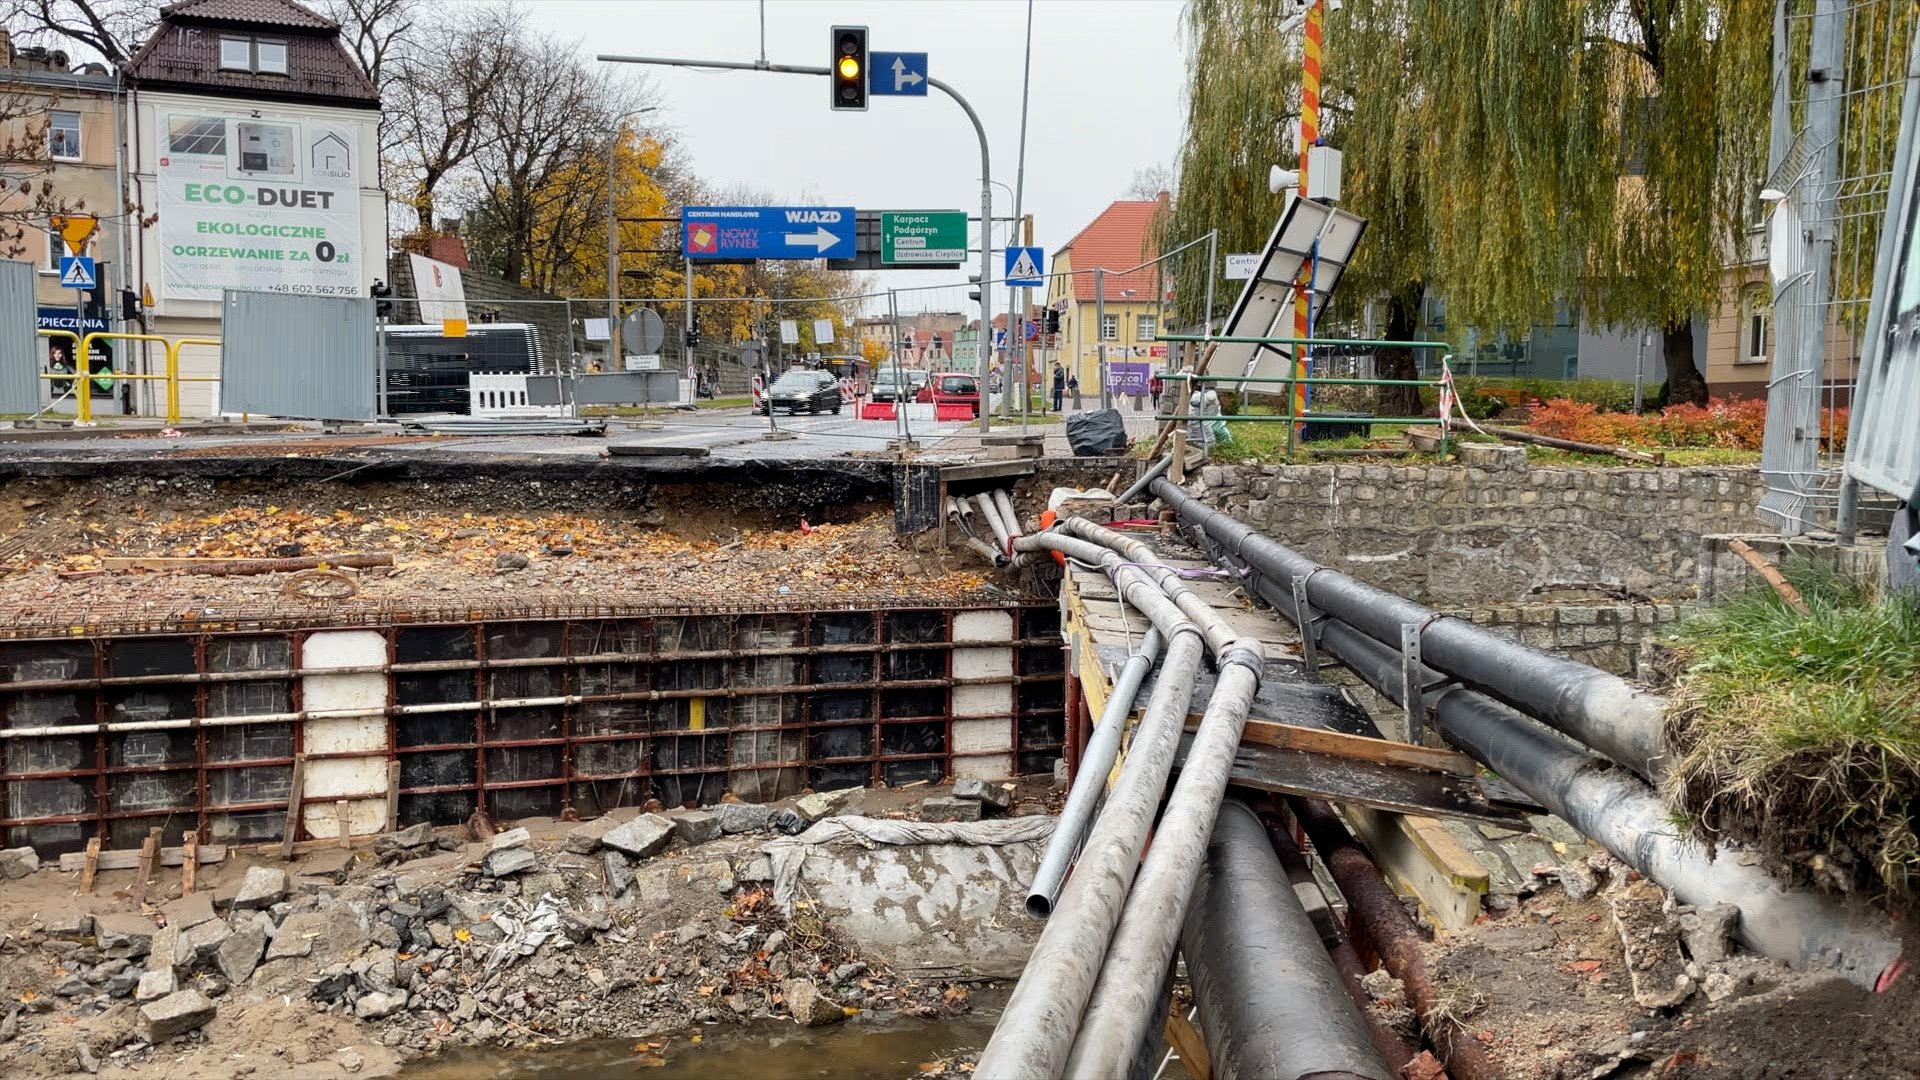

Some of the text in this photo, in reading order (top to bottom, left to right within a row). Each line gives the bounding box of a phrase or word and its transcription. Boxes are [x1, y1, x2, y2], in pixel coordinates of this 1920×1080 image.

[312, 170, 351, 178] CONSILIO
[184, 183, 335, 209] ECO-DUET
[784, 211, 842, 223] WJAZD
[894, 215, 928, 226] Karpacz
[196, 221, 326, 239] EKOLOGICZNE
[720, 229, 759, 238] NOWY
[894, 225, 938, 236] Podgórzyn
[720, 239, 760, 249] RYNEK
[172, 244, 284, 261] OGRZEWANIE
[289, 250, 311, 261] ZA
[935, 251, 963, 259] Cieplice
[268, 284, 289, 292] +48
[292, 284, 313, 293] 602
[315, 286, 335, 294] 562
[337, 287, 358, 295] 756
